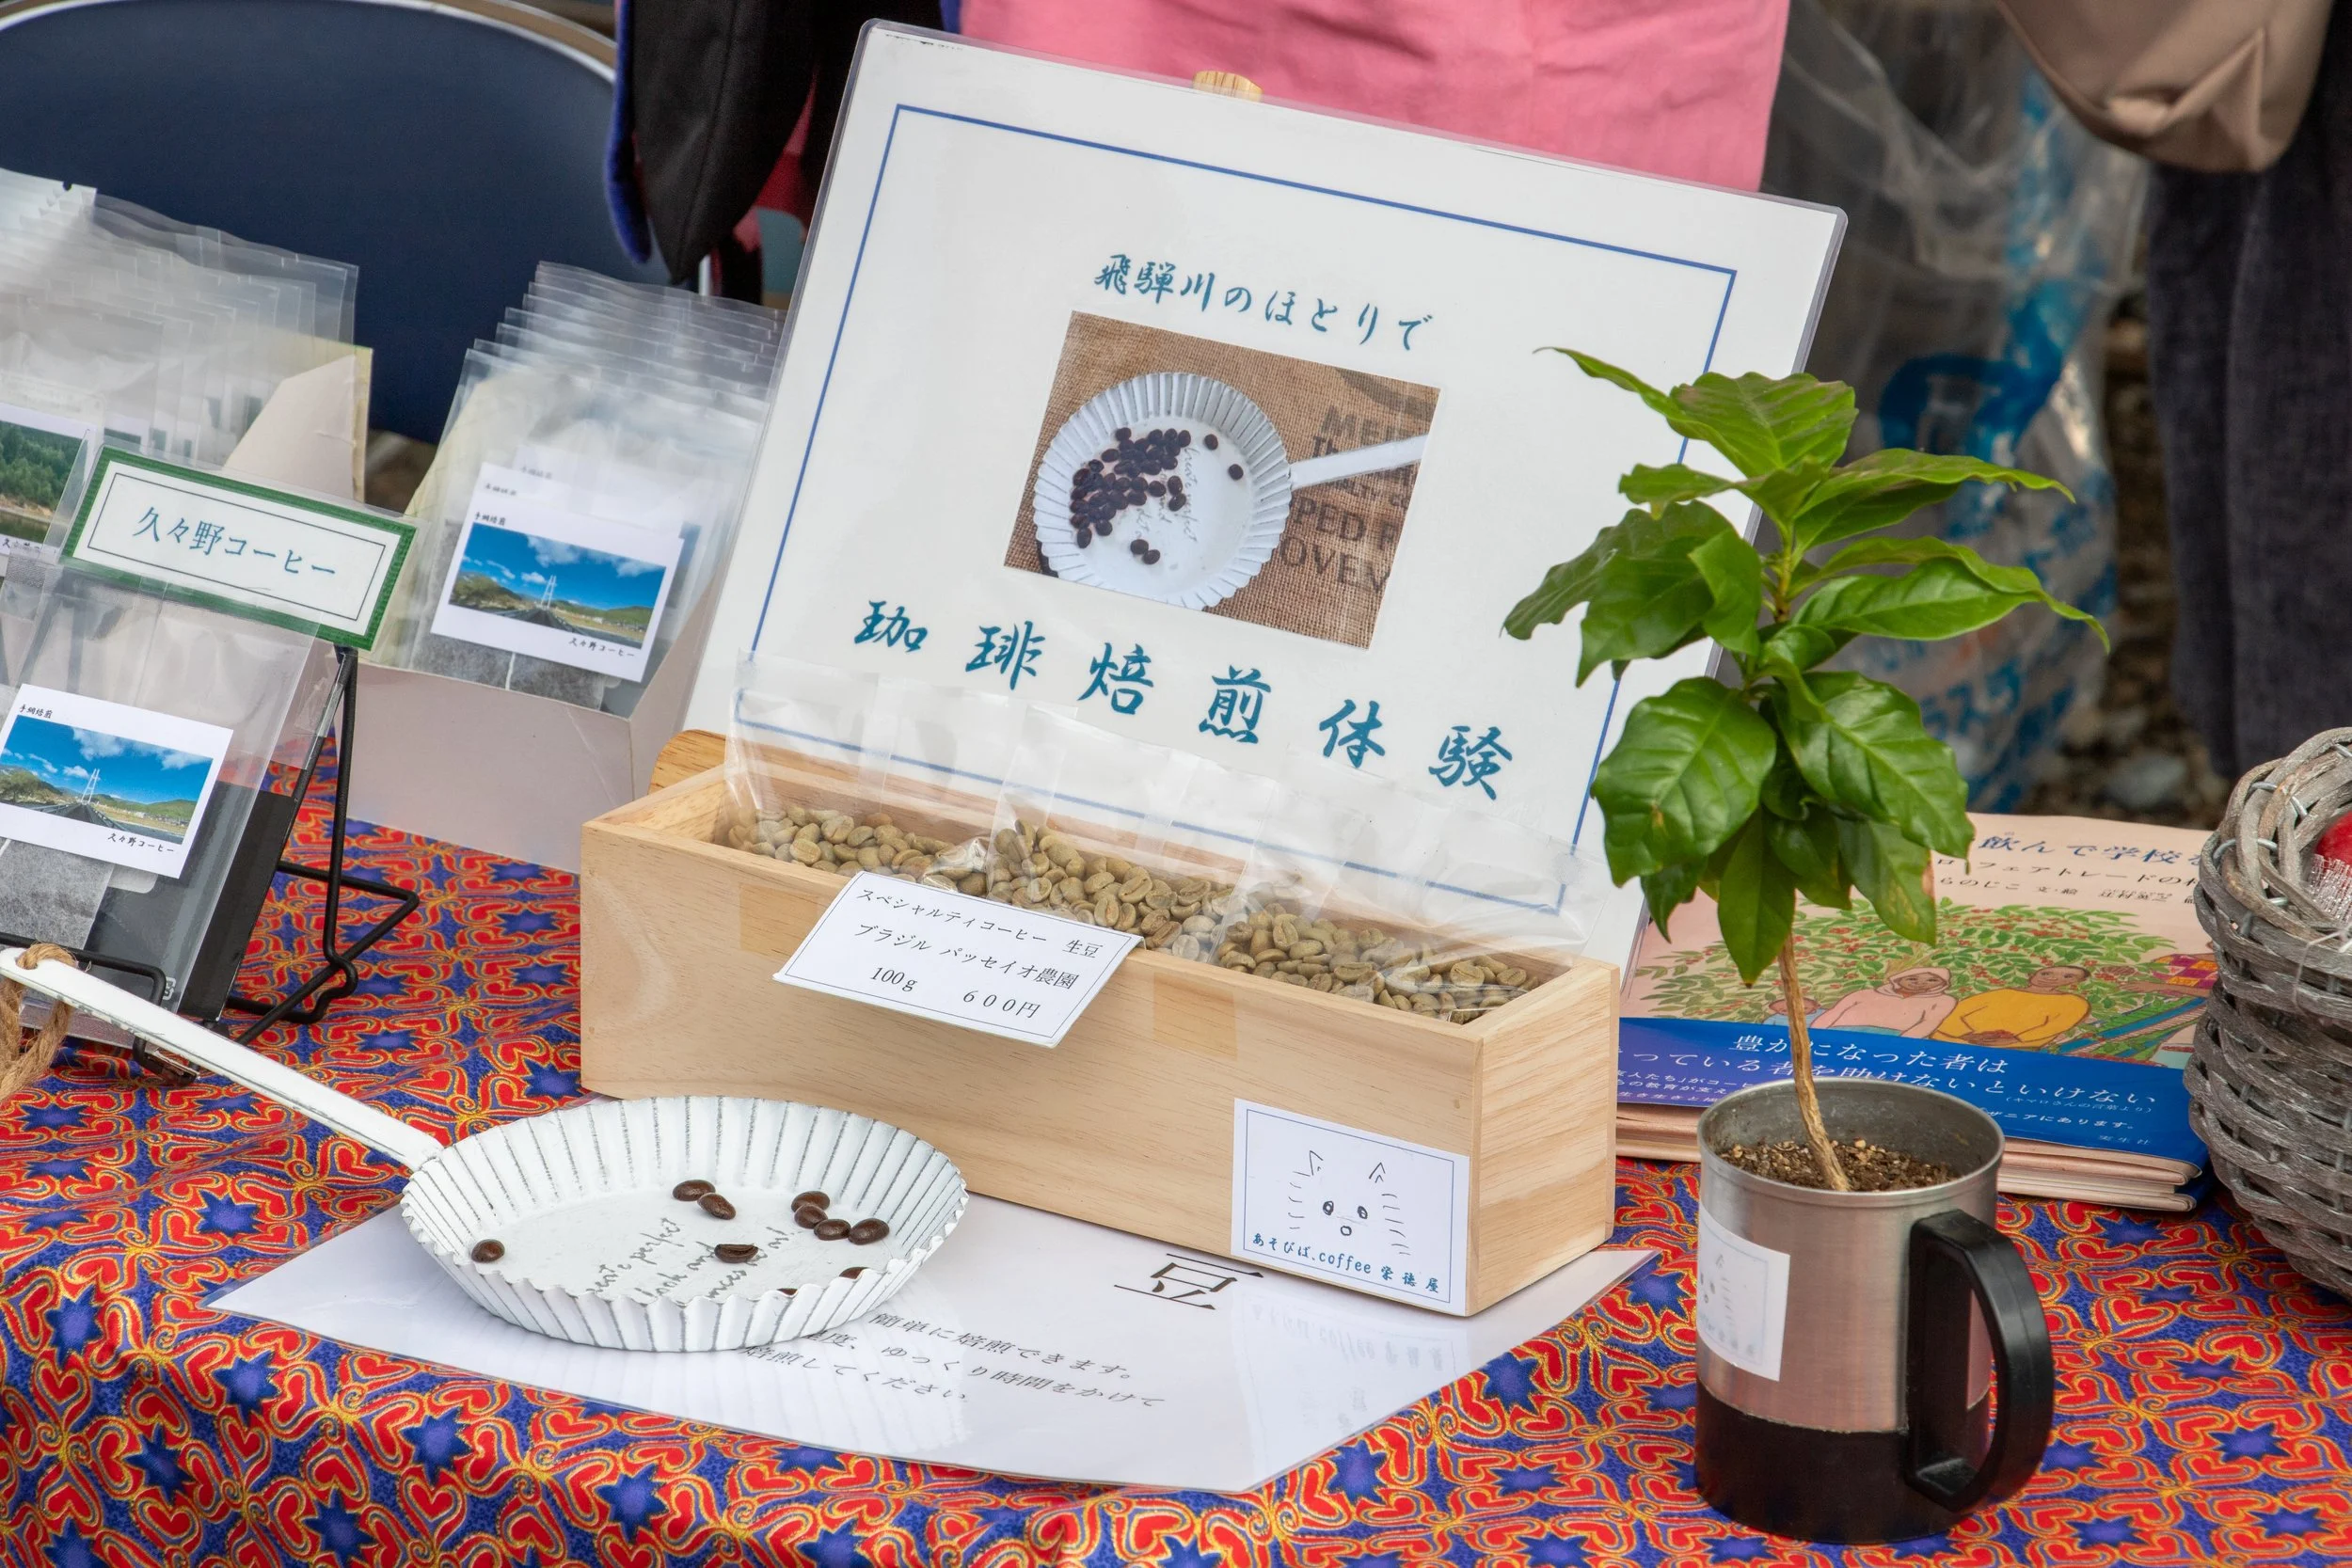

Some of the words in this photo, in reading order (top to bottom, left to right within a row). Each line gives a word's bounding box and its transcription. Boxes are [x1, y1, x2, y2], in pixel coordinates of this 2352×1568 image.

[1095, 254, 1433, 350] 飛騨川のほとりで
[133, 506, 336, 578] 久々野コーヒー
[107, 833, 175, 854] 久々野コーヒー
[855, 924, 932, 951] ブラジル
[940, 946, 1079, 991] パッセイオ農園
[856, 889, 1047, 943] スペシャルティコーヒー
[1062, 939, 1104, 959] 生豆
[869, 967, 918, 992] 100g
[1114, 1253, 1263, 1310] 豆
[868, 1312, 1132, 1379] 簡単に焙煎できます。
[881, 1345, 1167, 1407] ゆっくり時間をかけて
